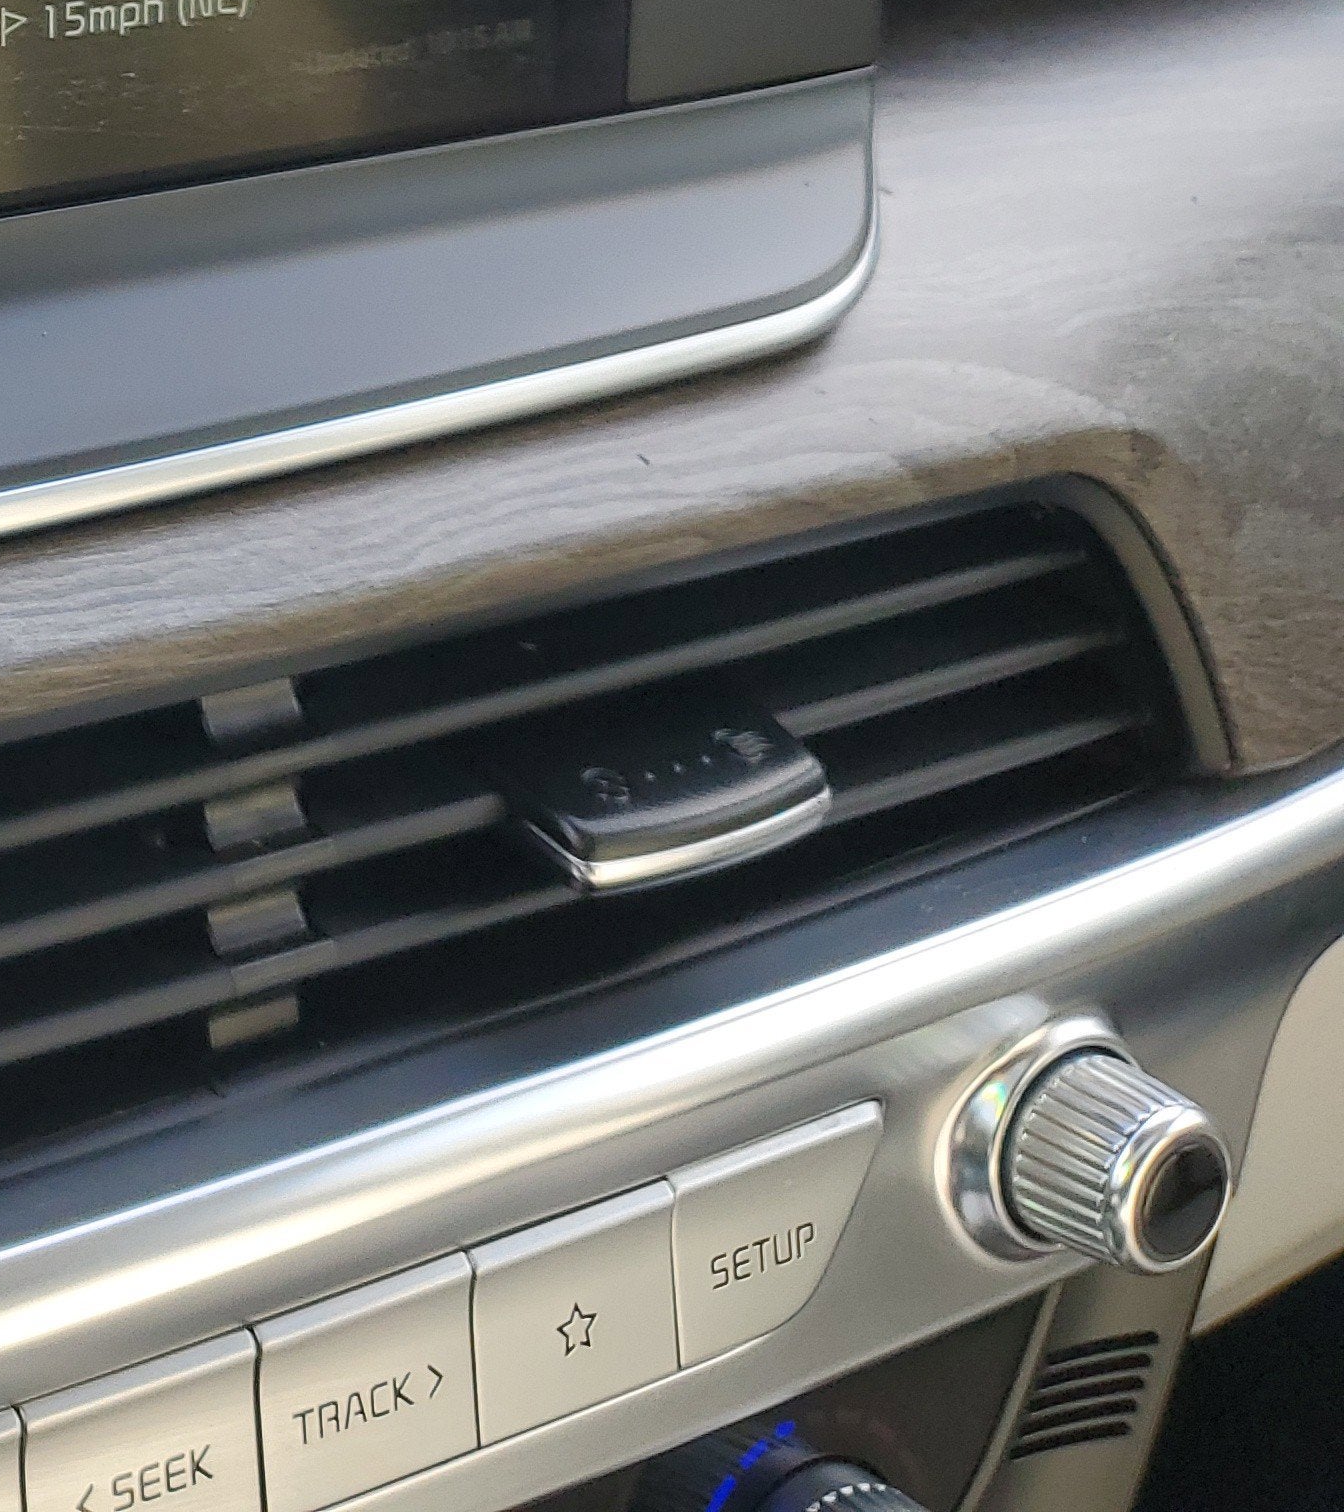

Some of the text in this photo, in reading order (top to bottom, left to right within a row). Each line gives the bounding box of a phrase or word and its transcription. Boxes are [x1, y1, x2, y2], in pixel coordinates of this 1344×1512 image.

[711, 1222, 817, 1290] SETUP
[292, 1371, 415, 1445] TRACK
[112, 1443, 214, 1512] SEEK
